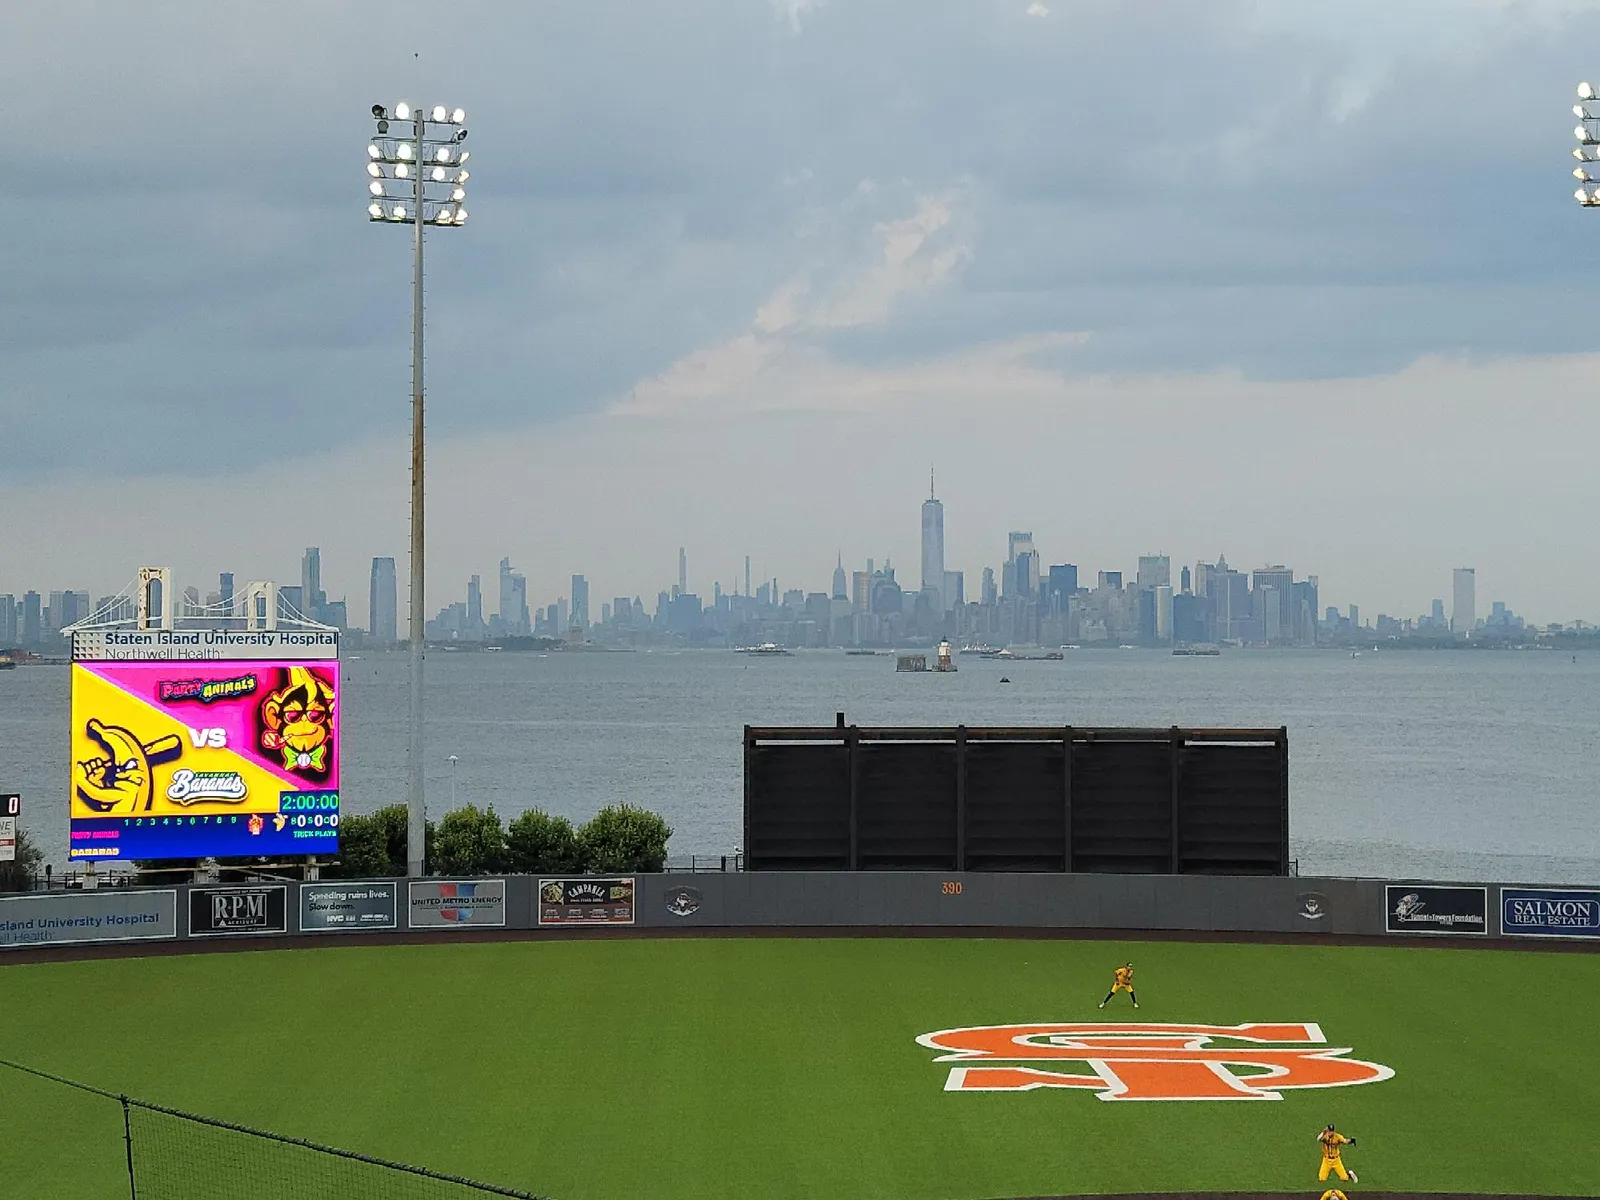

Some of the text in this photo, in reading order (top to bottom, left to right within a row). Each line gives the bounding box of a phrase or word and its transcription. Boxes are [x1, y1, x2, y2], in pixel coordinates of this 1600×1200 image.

[105, 632, 337, 647] Staten Island University Hospital
[105, 648, 220, 660] Northwell Health
[202, 678, 256, 698] ANIMALS
[189, 728, 227, 748] VS
[167, 769, 246, 800] Bananas
[282, 794, 339, 810] 2:00:00
[942, 881, 962, 894] 390
[308, 889, 390, 902] Speeding ruins lives.
[309, 902, 328, 911] Slow
[1514, 901, 1591, 917] SALMON
[38, 915, 102, 929] University
[106, 913, 159, 926] Hospital
[1514, 915, 1591, 926] REAL ESTATE
